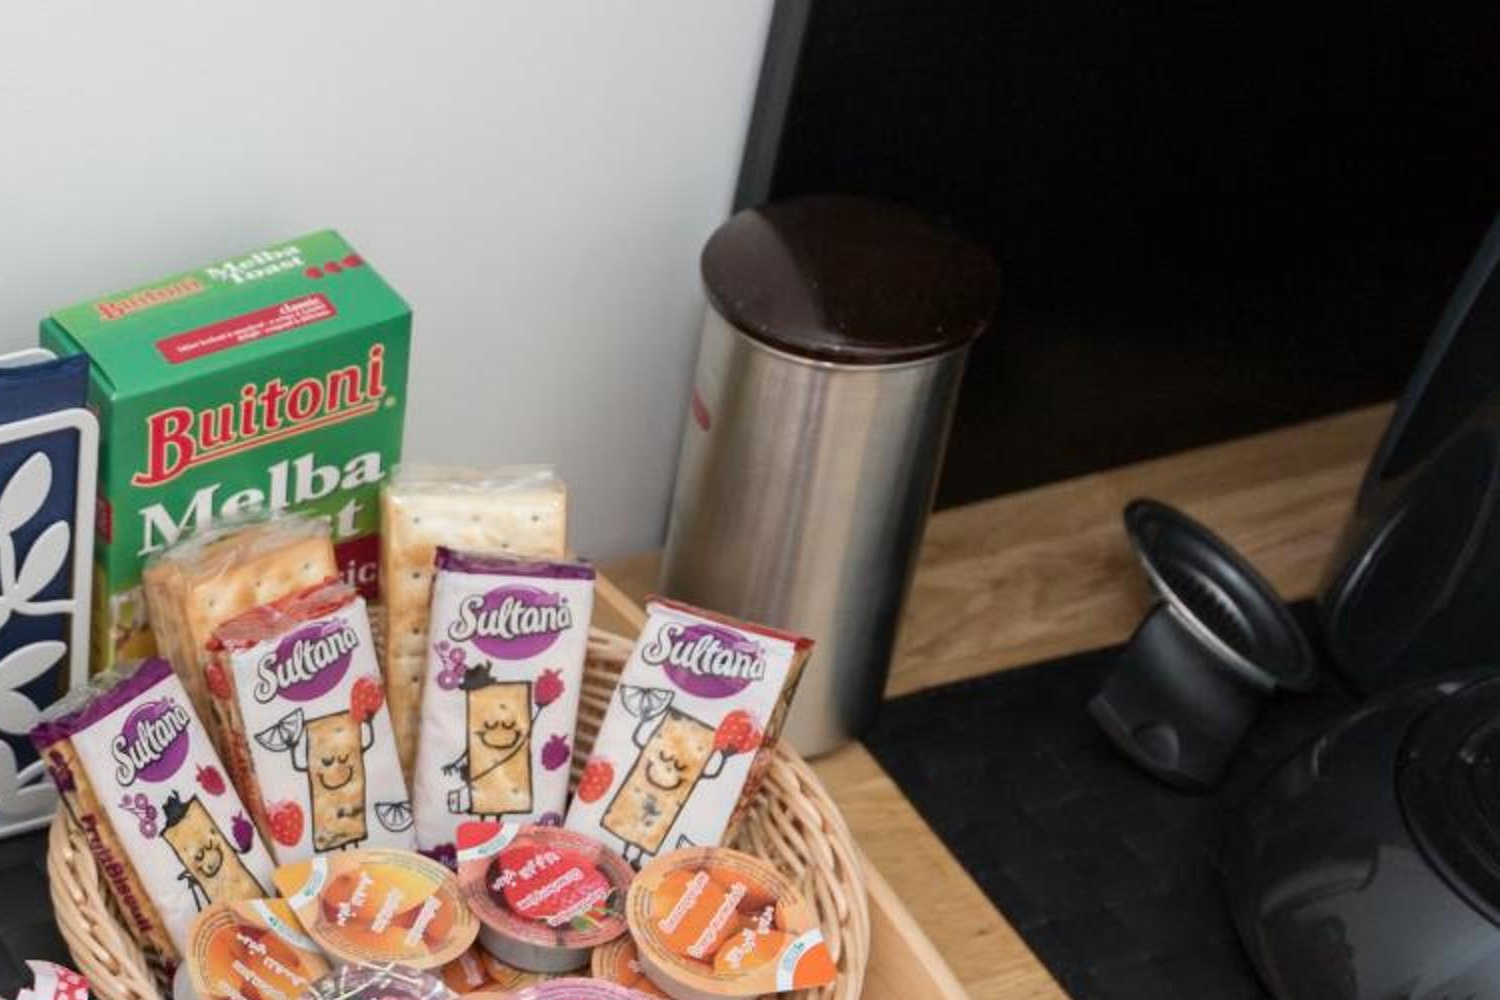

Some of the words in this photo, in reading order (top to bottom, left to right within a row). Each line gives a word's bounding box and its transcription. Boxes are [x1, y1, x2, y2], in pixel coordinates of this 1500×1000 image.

[131, 343, 386, 486] Buitoni
[137, 451, 386, 556] Melba
[449, 593, 573, 642] Sultana
[642, 621, 767, 682] Sultana
[254, 623, 360, 705] Sultana
[111, 703, 191, 787] Sultana
